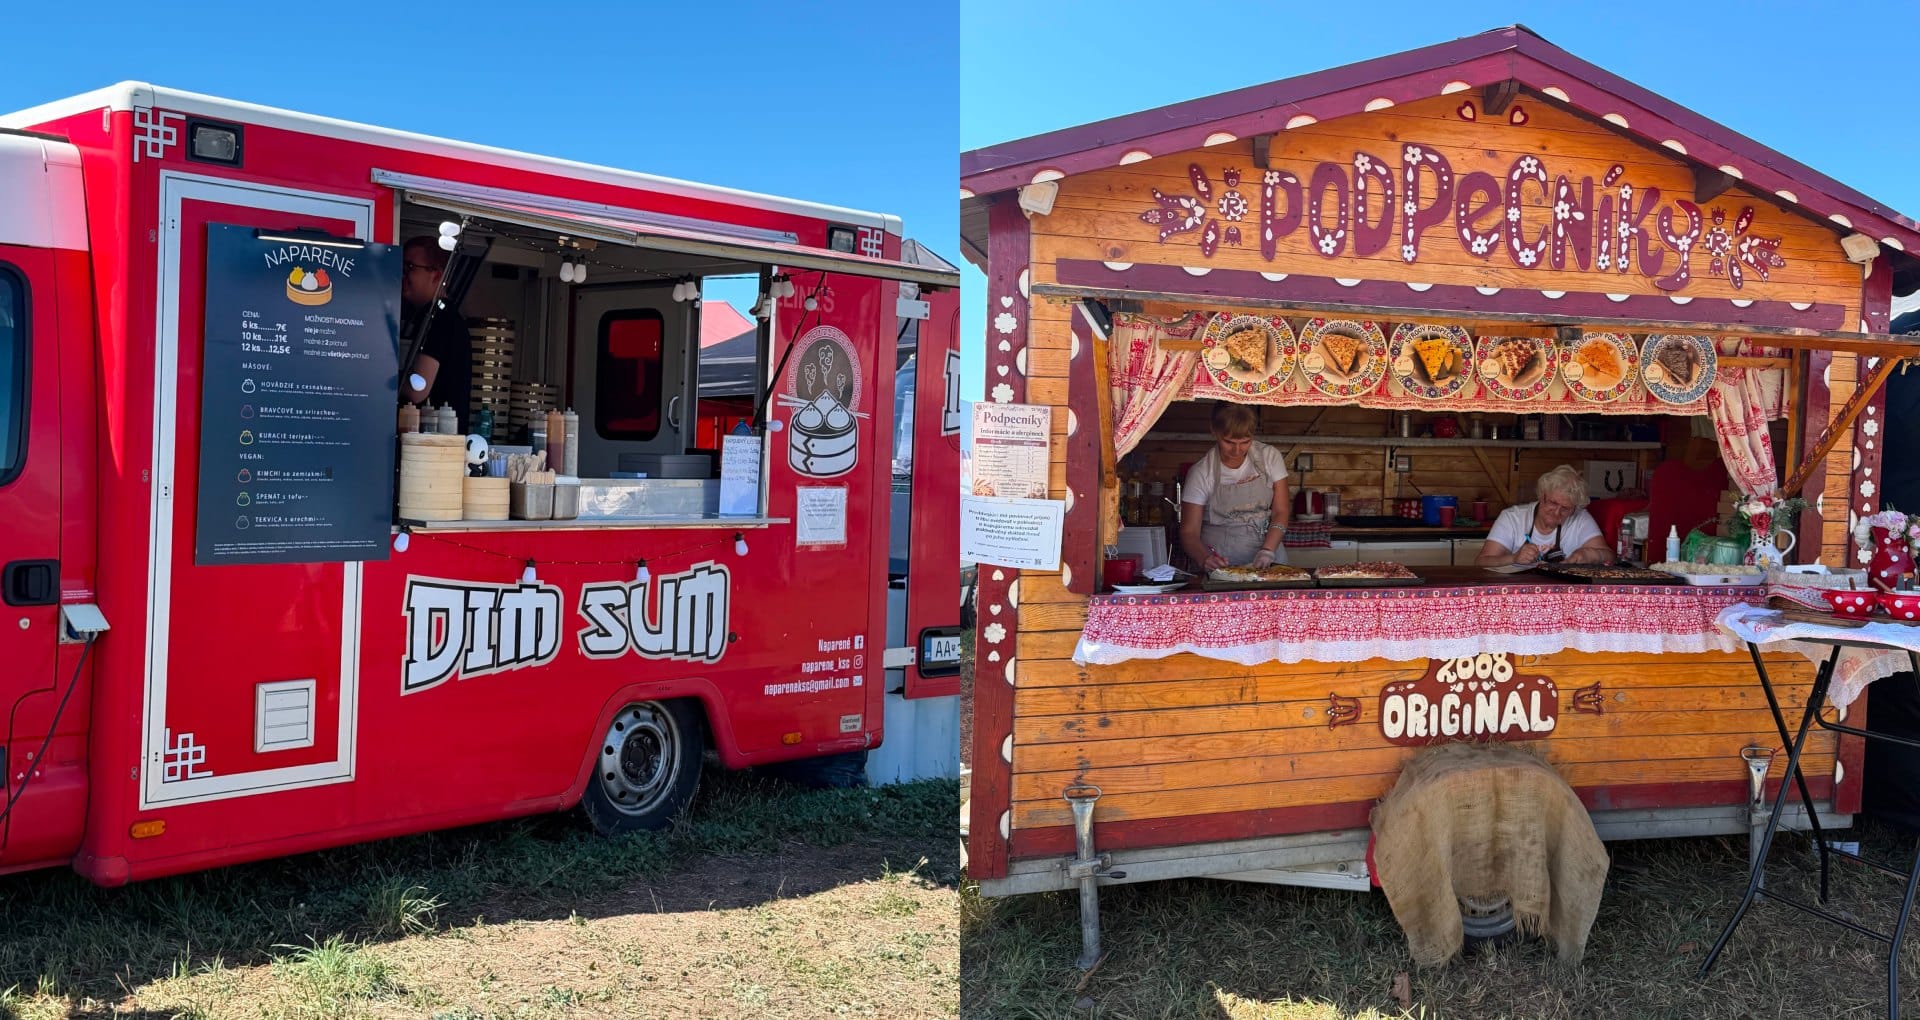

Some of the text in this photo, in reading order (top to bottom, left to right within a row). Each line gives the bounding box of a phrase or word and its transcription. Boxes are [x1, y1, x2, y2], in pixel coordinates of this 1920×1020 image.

[264, 245, 355, 277] NAPARENÉ
[983, 411, 1042, 428] Podpecníky
[402, 560, 731, 695] DIM SUM
[818, 637, 851, 653] Naparené
[802, 658, 850, 674] naparene_ksc
[1436, 652, 1514, 683] 2008
[764, 677, 850, 696] napareneksc@gmail.com
